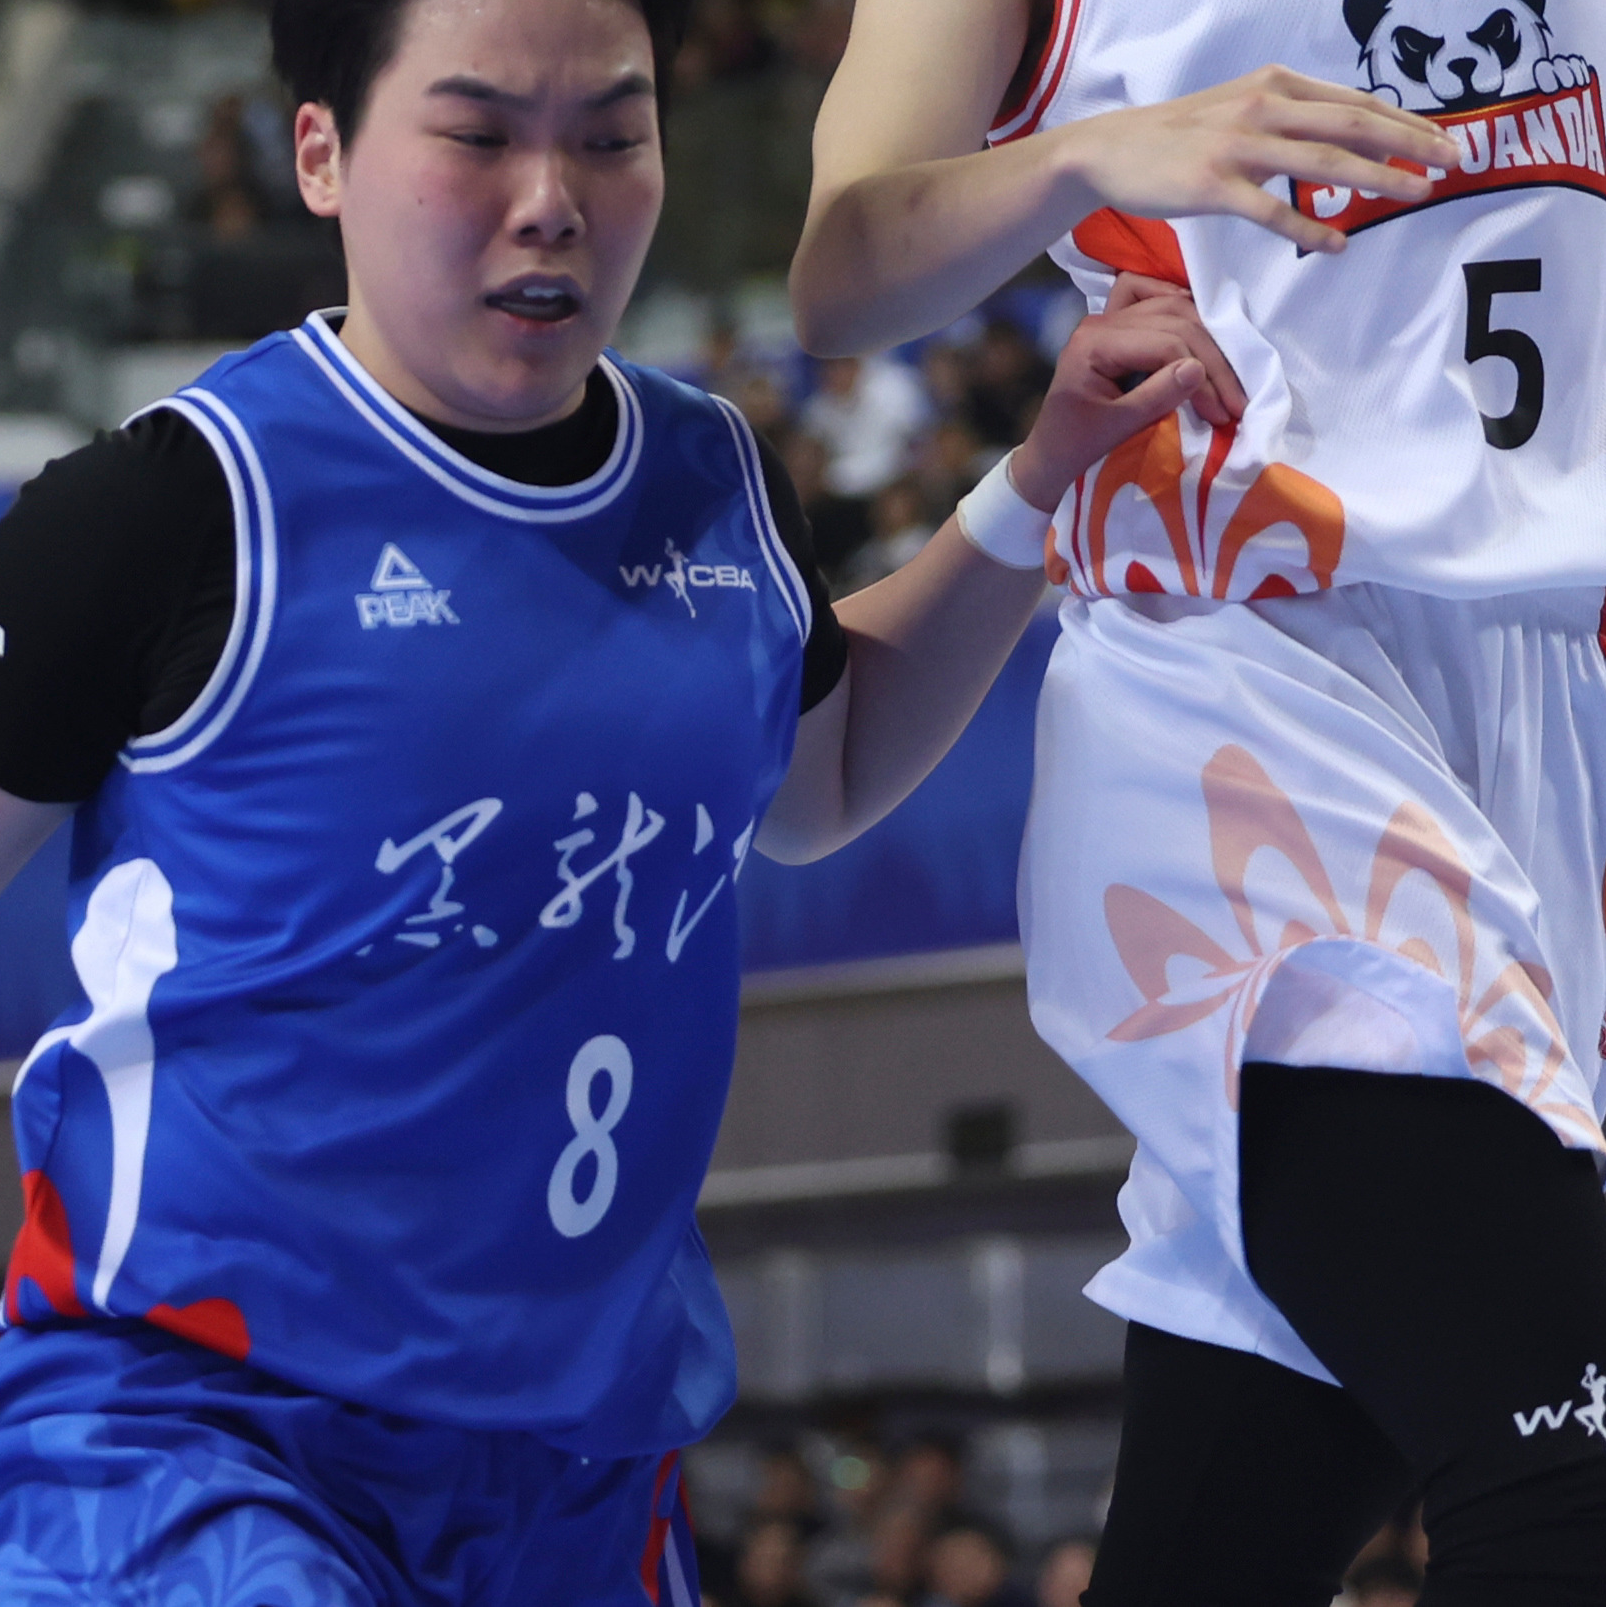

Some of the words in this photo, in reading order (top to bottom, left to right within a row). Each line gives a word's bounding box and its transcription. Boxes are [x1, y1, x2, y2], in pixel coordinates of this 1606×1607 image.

[1461, 258, 1545, 450] 5
[355, 589, 461, 631] PEAK
[547, 1033, 634, 1238] 8
